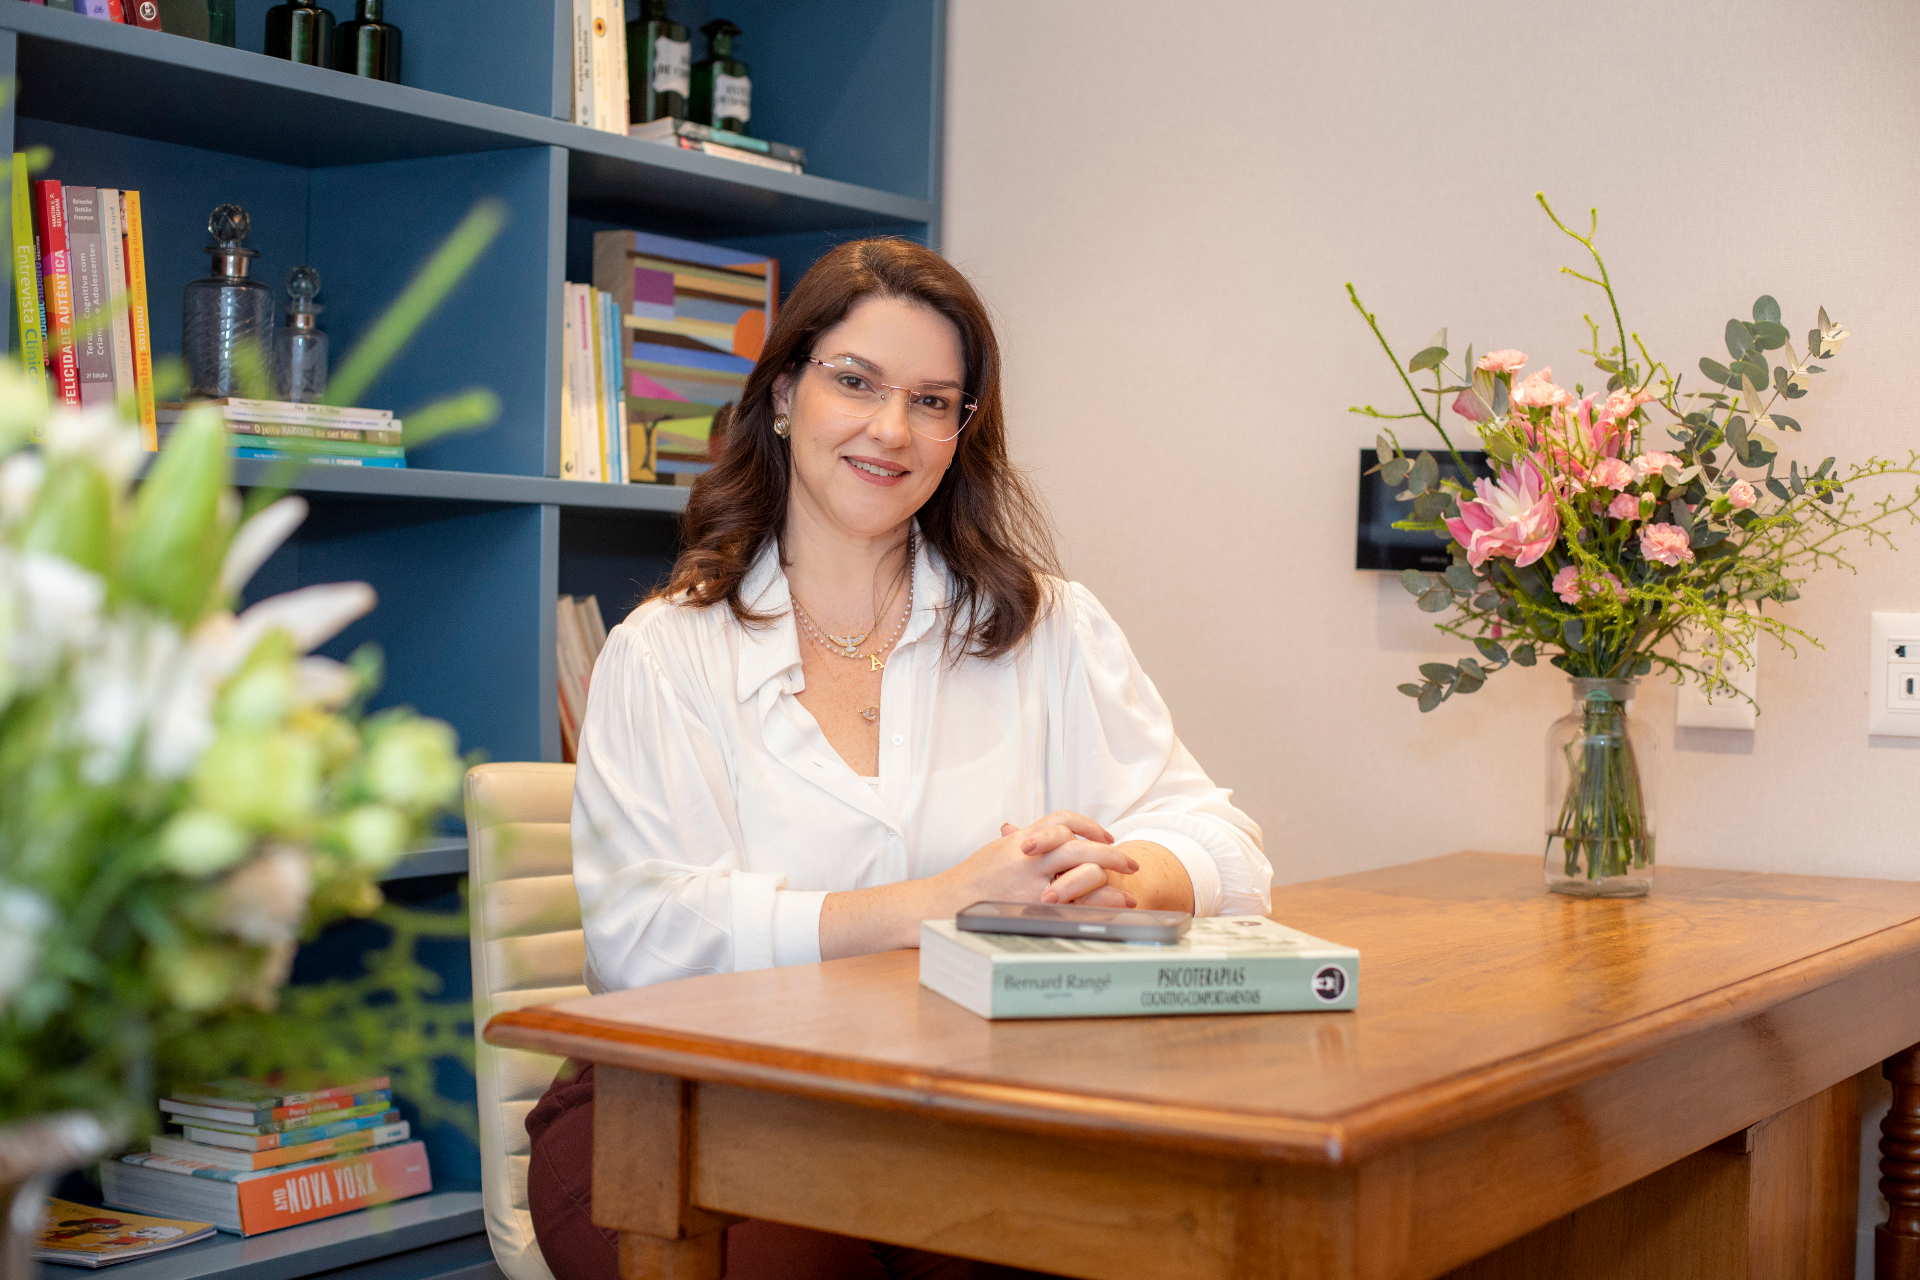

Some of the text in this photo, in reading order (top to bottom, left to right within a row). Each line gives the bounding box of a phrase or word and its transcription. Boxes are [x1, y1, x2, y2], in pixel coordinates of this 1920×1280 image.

[82, 276, 91, 319] Cognitiva
[90, 243, 99, 305] Adolescentes
[18, 245, 41, 386] Entrevista Clínica
[54, 250, 77, 405] FELICIDADE AUTÊNTICA
[136, 306, 152, 425] mentes inquietas
[254, 423, 260, 433] O
[870, 653, 886, 672] A
[1003, 971, 1112, 995] Bernard Rangé
[1157, 966, 1246, 988] PSICOTERAPIAS
[285, 1171, 333, 1214] NOVA
[333, 1162, 378, 1202] YORK
